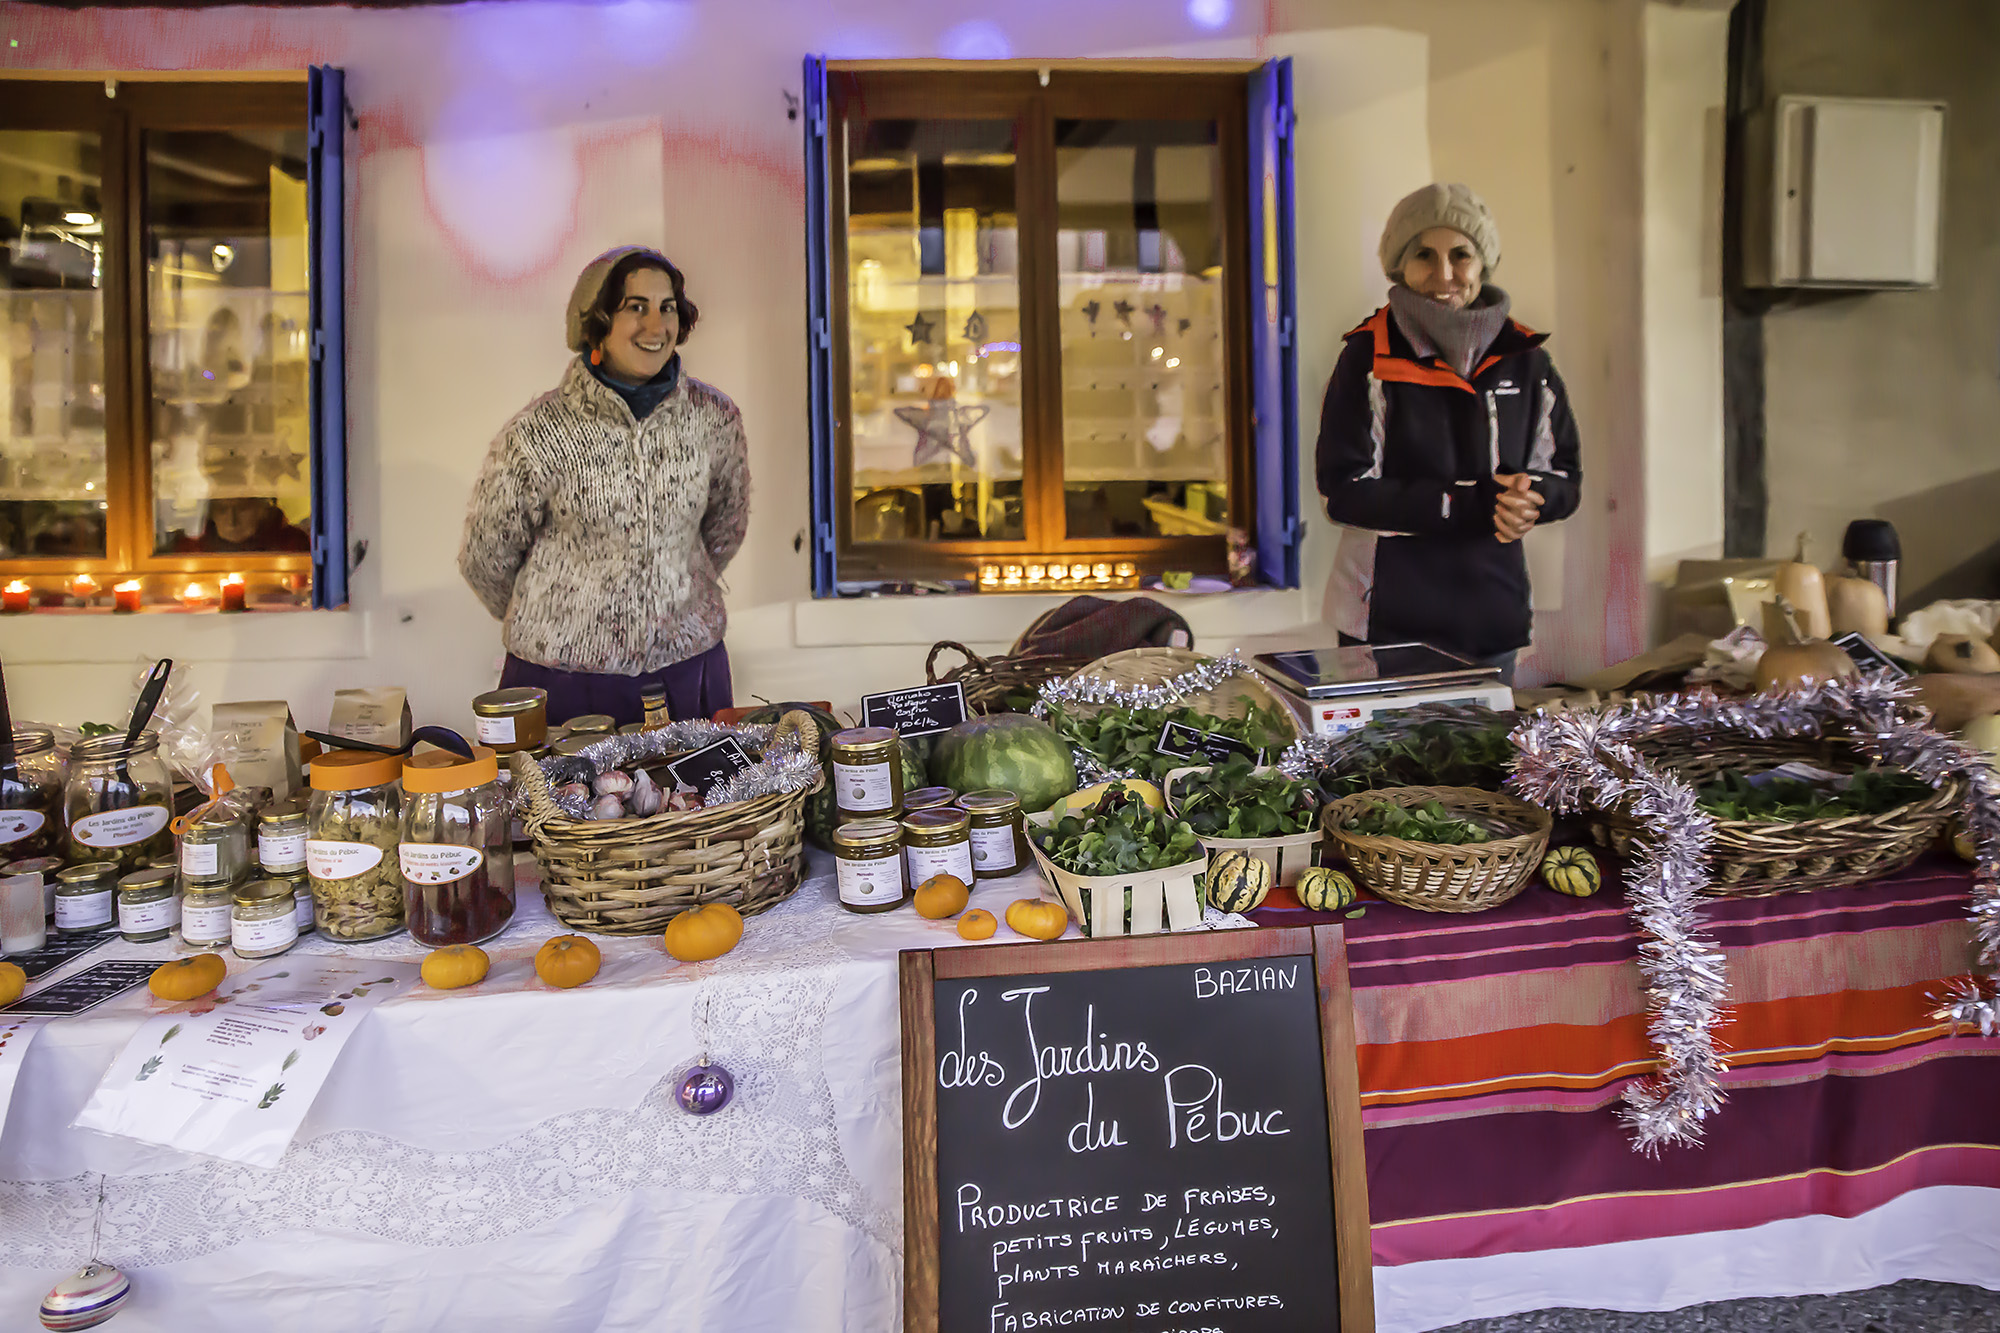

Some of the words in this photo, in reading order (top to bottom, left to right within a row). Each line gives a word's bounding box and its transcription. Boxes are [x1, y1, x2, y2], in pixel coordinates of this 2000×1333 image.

[1000, 984, 1161, 1130] Jardins
[1066, 1081, 1128, 1153] du
[1163, 1063, 1291, 1149] Pébuc
[1140, 1191, 1168, 1214] DE
[1135, 1303, 1161, 1317] DE
